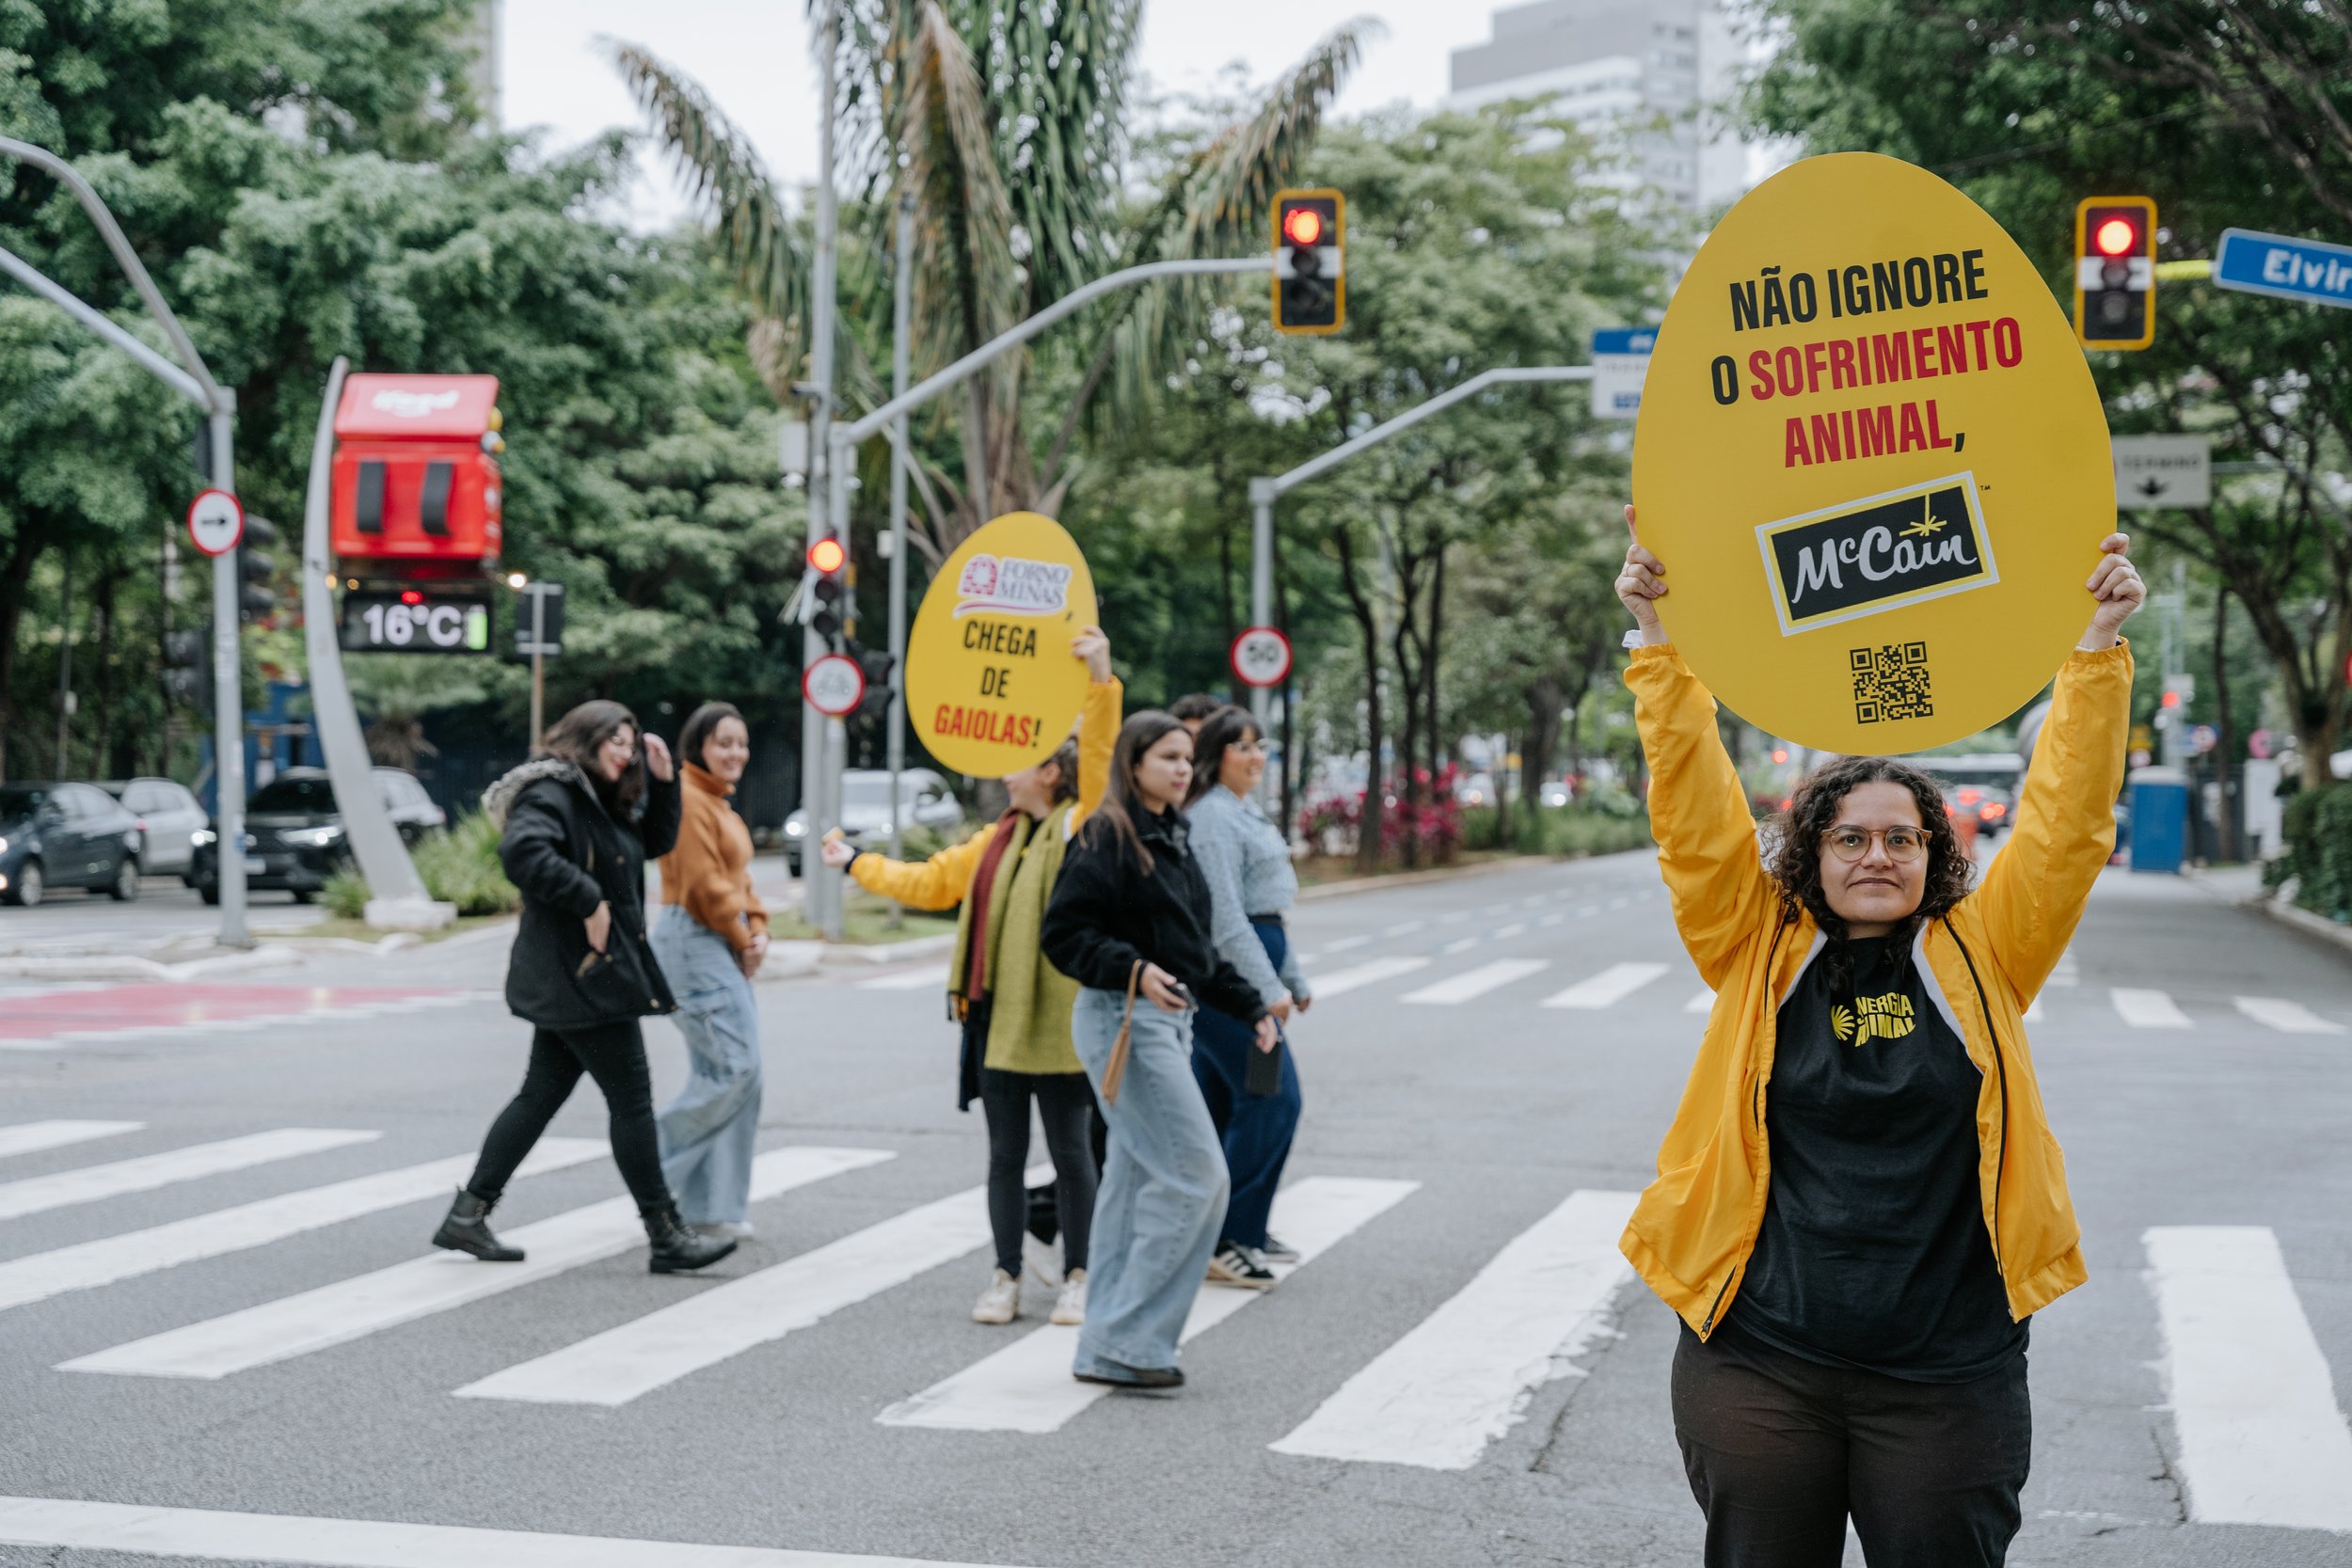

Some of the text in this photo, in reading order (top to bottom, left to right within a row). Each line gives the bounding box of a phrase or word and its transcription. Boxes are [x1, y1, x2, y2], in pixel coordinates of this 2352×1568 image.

[1729, 248, 1989, 332] NÃO IGNORE
[1710, 316, 2023, 405] O SOFRIMENTO
[1784, 399, 1966, 468] ANIMAL,
[1001, 560, 1071, 585] FORNO
[1790, 523, 1978, 605] McCain
[963, 619, 1038, 658] CHEGA
[979, 666, 1010, 699] DE
[933, 703, 1042, 748] GAIOLAS!
